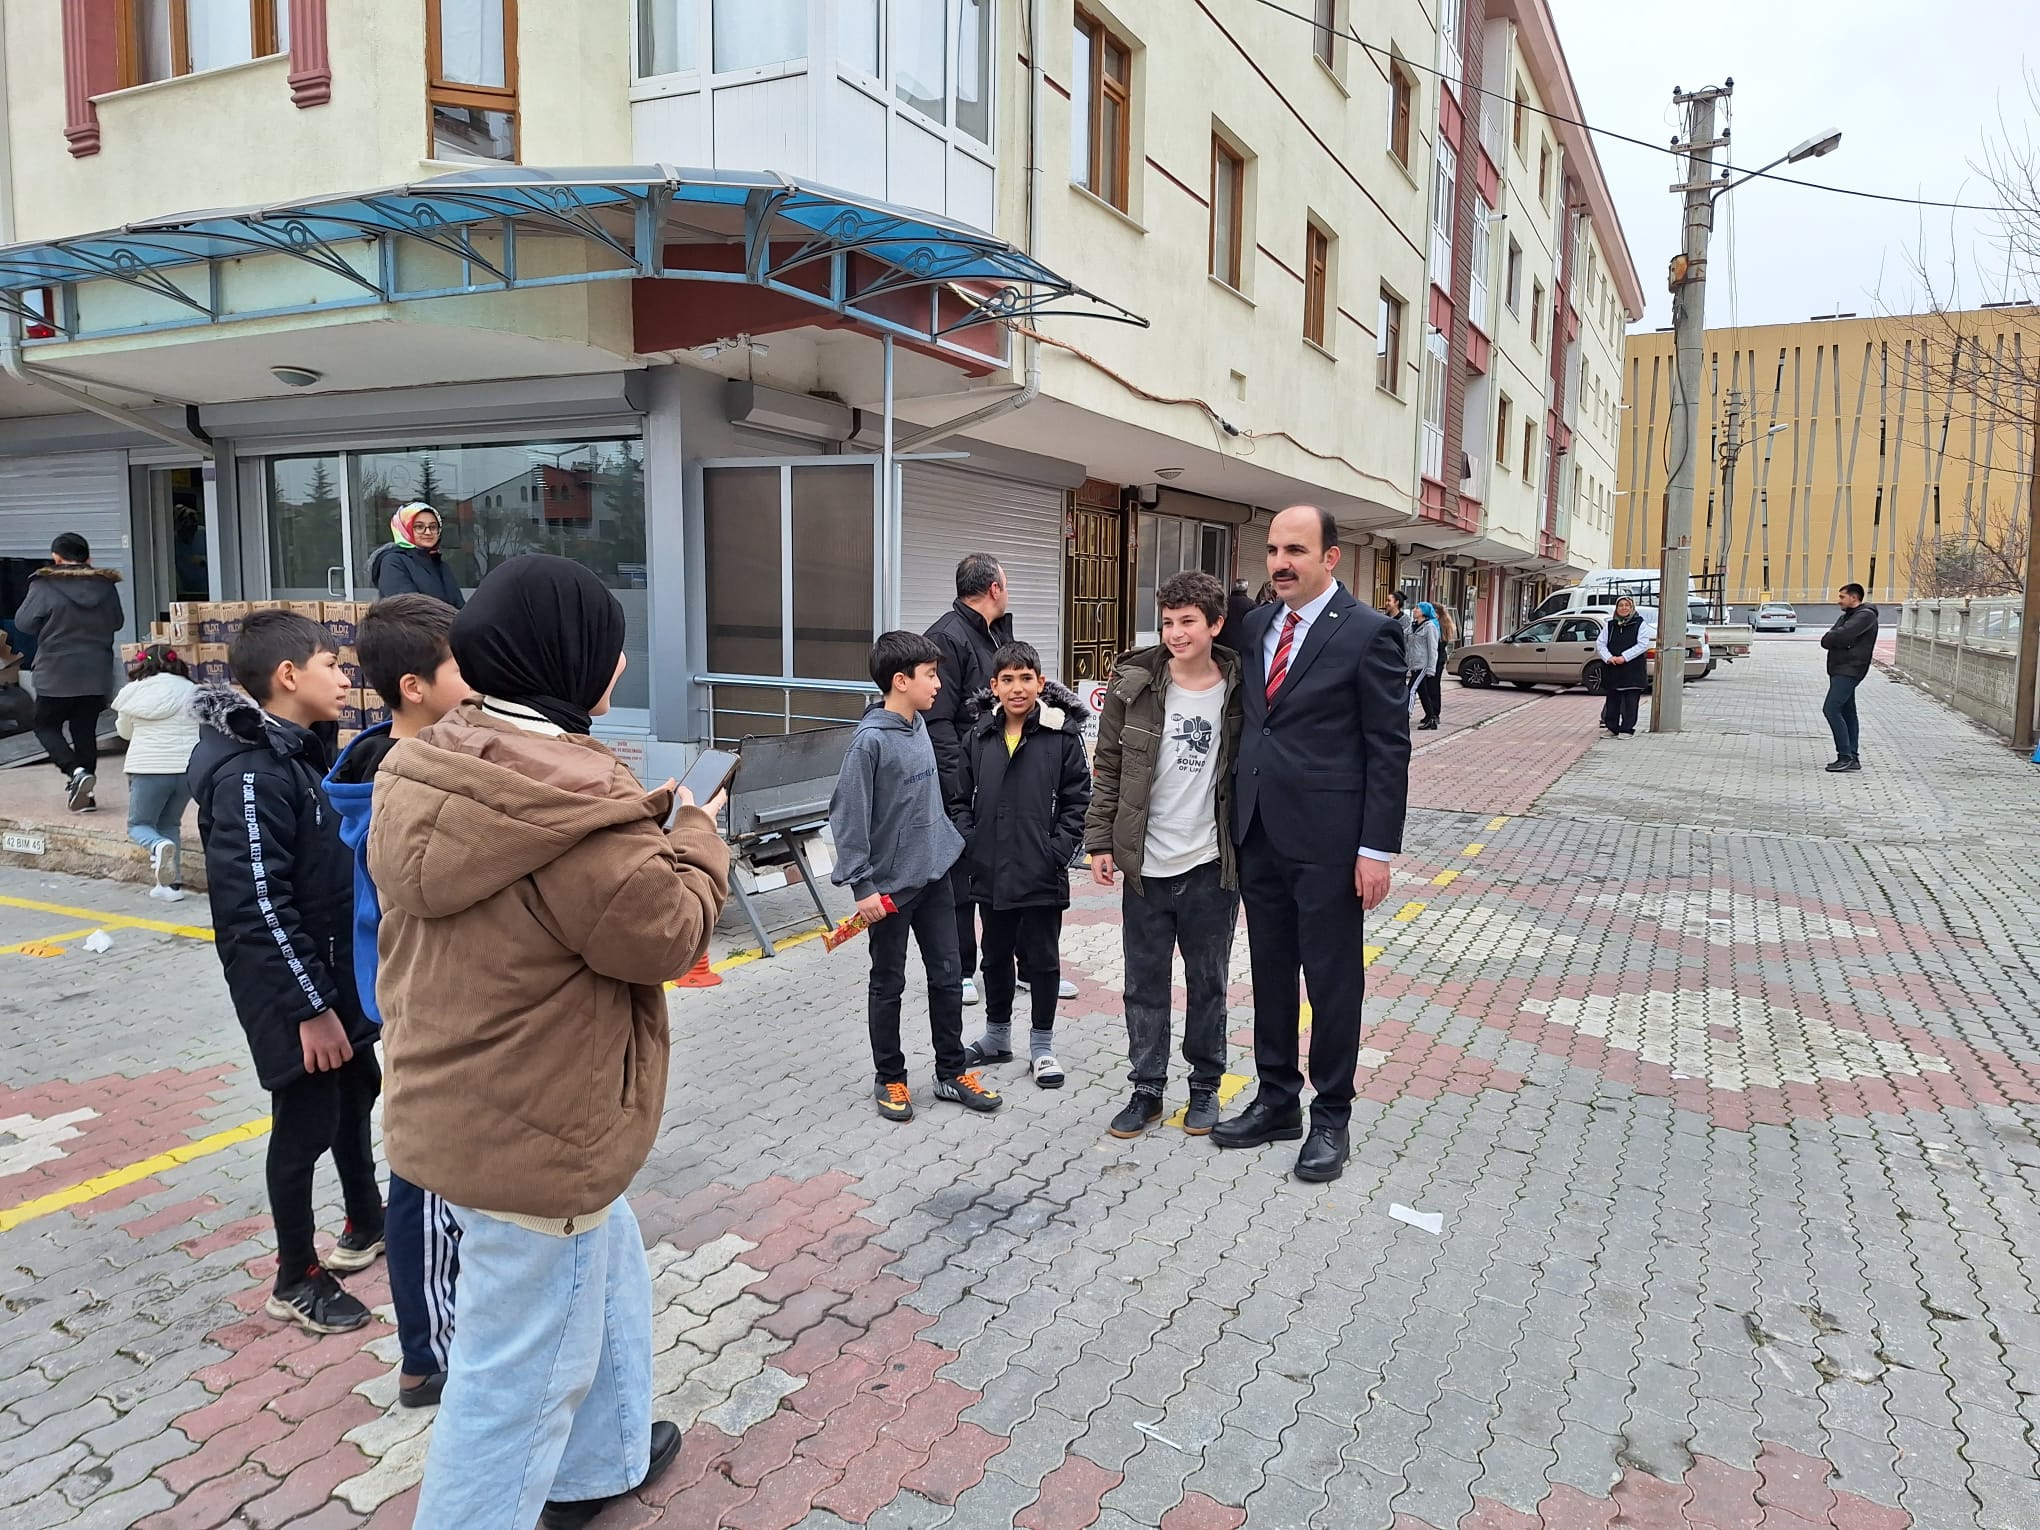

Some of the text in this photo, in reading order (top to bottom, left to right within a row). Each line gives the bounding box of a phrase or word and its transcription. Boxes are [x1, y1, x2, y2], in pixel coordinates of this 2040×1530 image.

[1176, 758, 1206, 767] SOUND
[243, 784, 256, 803] COOL
[244, 804, 257, 823] KEEP
[6, 836, 15, 848] 42
[247, 823, 261, 843] COOL
[250, 843, 262, 862] KEEP
[288, 958, 305, 976] COOL
[297, 973, 315, 992] KEEP
